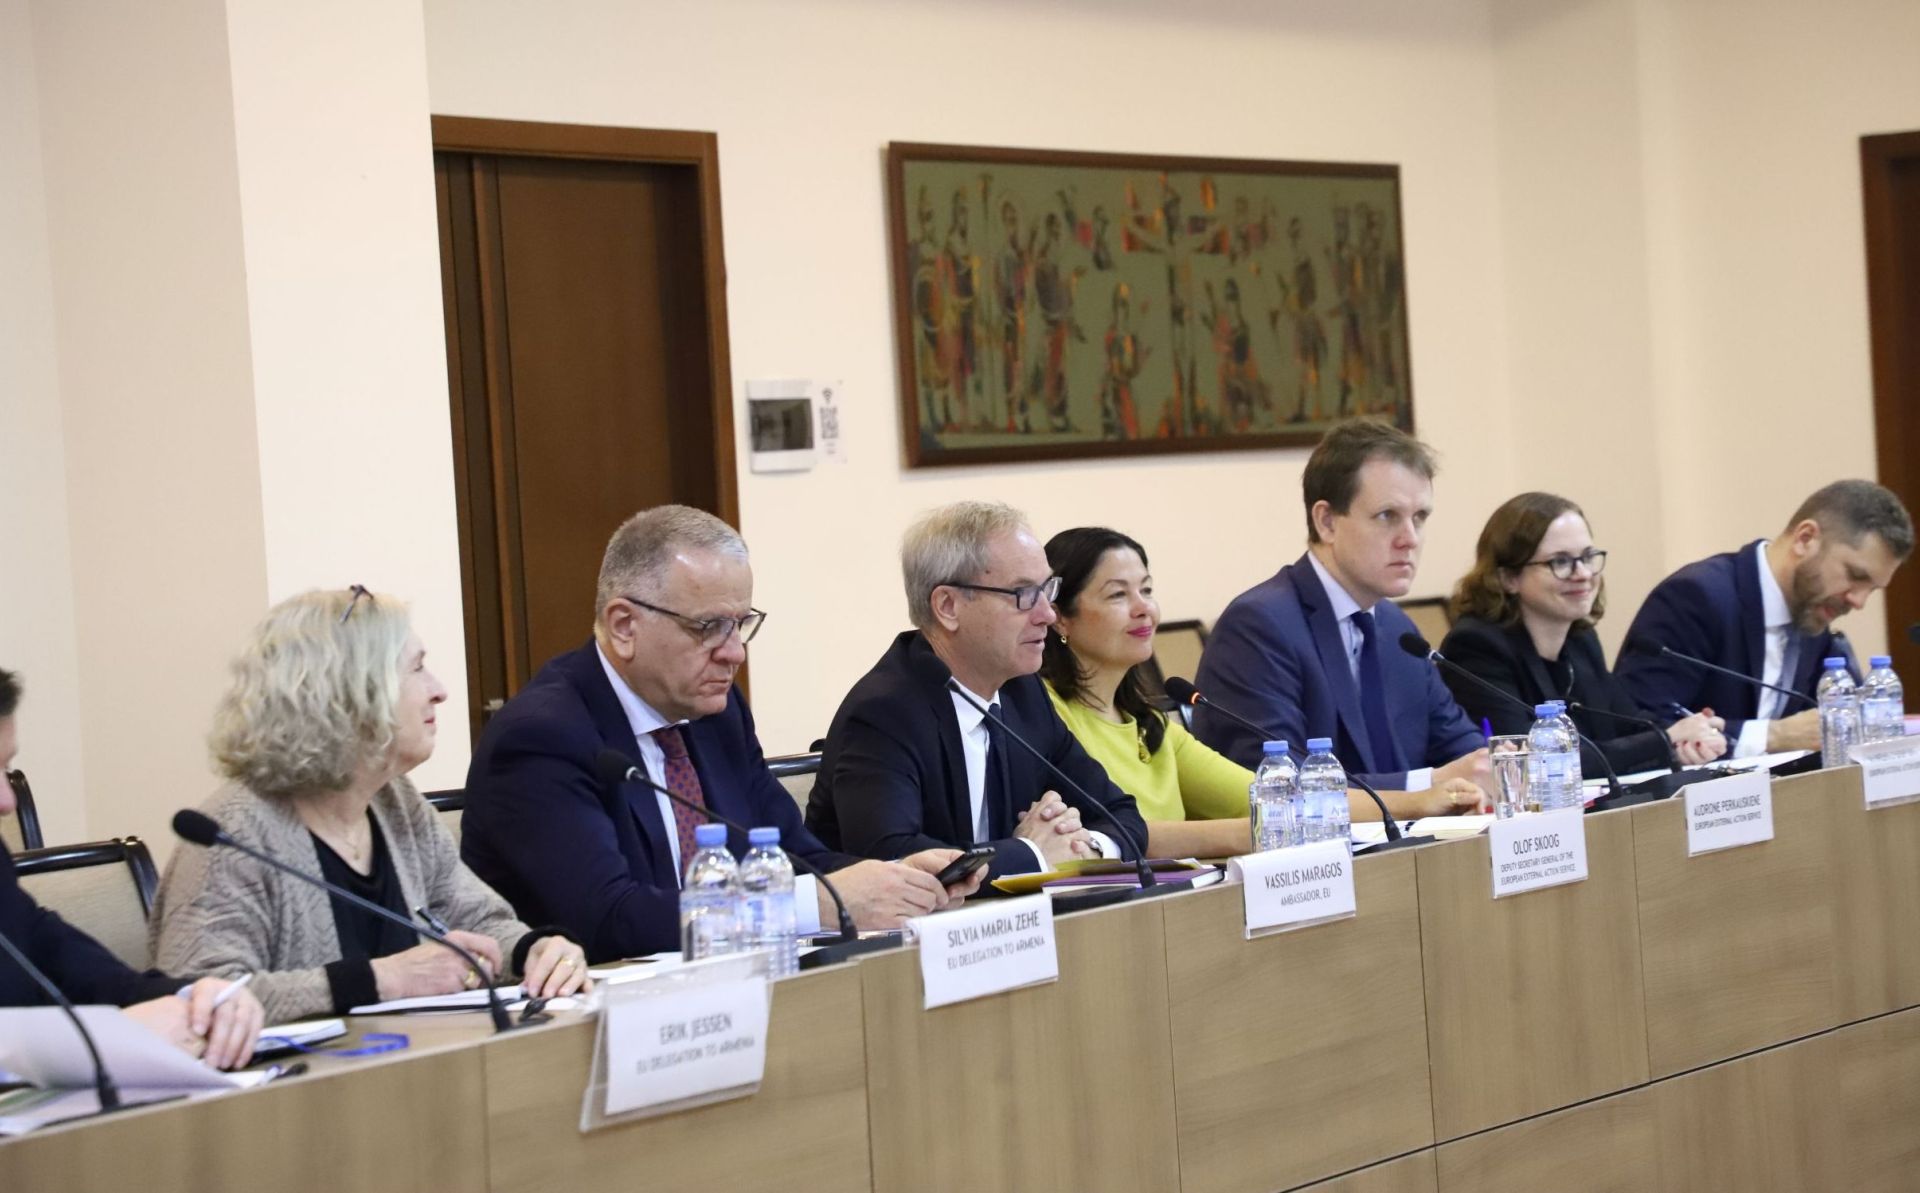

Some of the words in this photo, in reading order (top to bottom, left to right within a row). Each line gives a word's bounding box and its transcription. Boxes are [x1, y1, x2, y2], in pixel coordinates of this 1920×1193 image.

[1733, 814, 1747, 823] ACTION
[1747, 811, 1761, 821] SERVICE
[1513, 838, 1533, 855] OLOF
[1534, 833, 1560, 851] SKOOG
[1500, 862, 1517, 873] DEPUTY
[1517, 858, 1540, 870] SECRETARY
[1540, 854, 1559, 865] GENERAL
[1559, 852, 1565, 861] OF
[1565, 850, 1574, 859] THE
[1264, 869, 1300, 889] VASSILIS
[1301, 862, 1343, 883] MARAGOS
[1500, 874, 1523, 886] EUROPEAN
[1523, 870, 1544, 881] EXTERNAL
[1544, 867, 1559, 877] ACTION
[1559, 863, 1576, 874] SERVICE
[1281, 889, 1323, 906] AMBASSADOR,
[1323, 887, 1331, 899] EU
[947, 927, 980, 949] SILVIA
[981, 918, 1013, 940] MARIA
[1015, 910, 1040, 931] ZEHE
[947, 957, 958, 970] EU
[959, 946, 1003, 968] DELEGATION
[1004, 942, 1015, 955] TO
[1016, 936, 1045, 952] ARMENIA
[659, 1022, 687, 1045] ERIK
[691, 1013, 732, 1041] JESSEN
[636, 1058, 648, 1075] EU
[651, 1047, 703, 1072] DELEGATION
[705, 1042, 717, 1057] TO
[719, 1036, 755, 1053] ARMENIA
